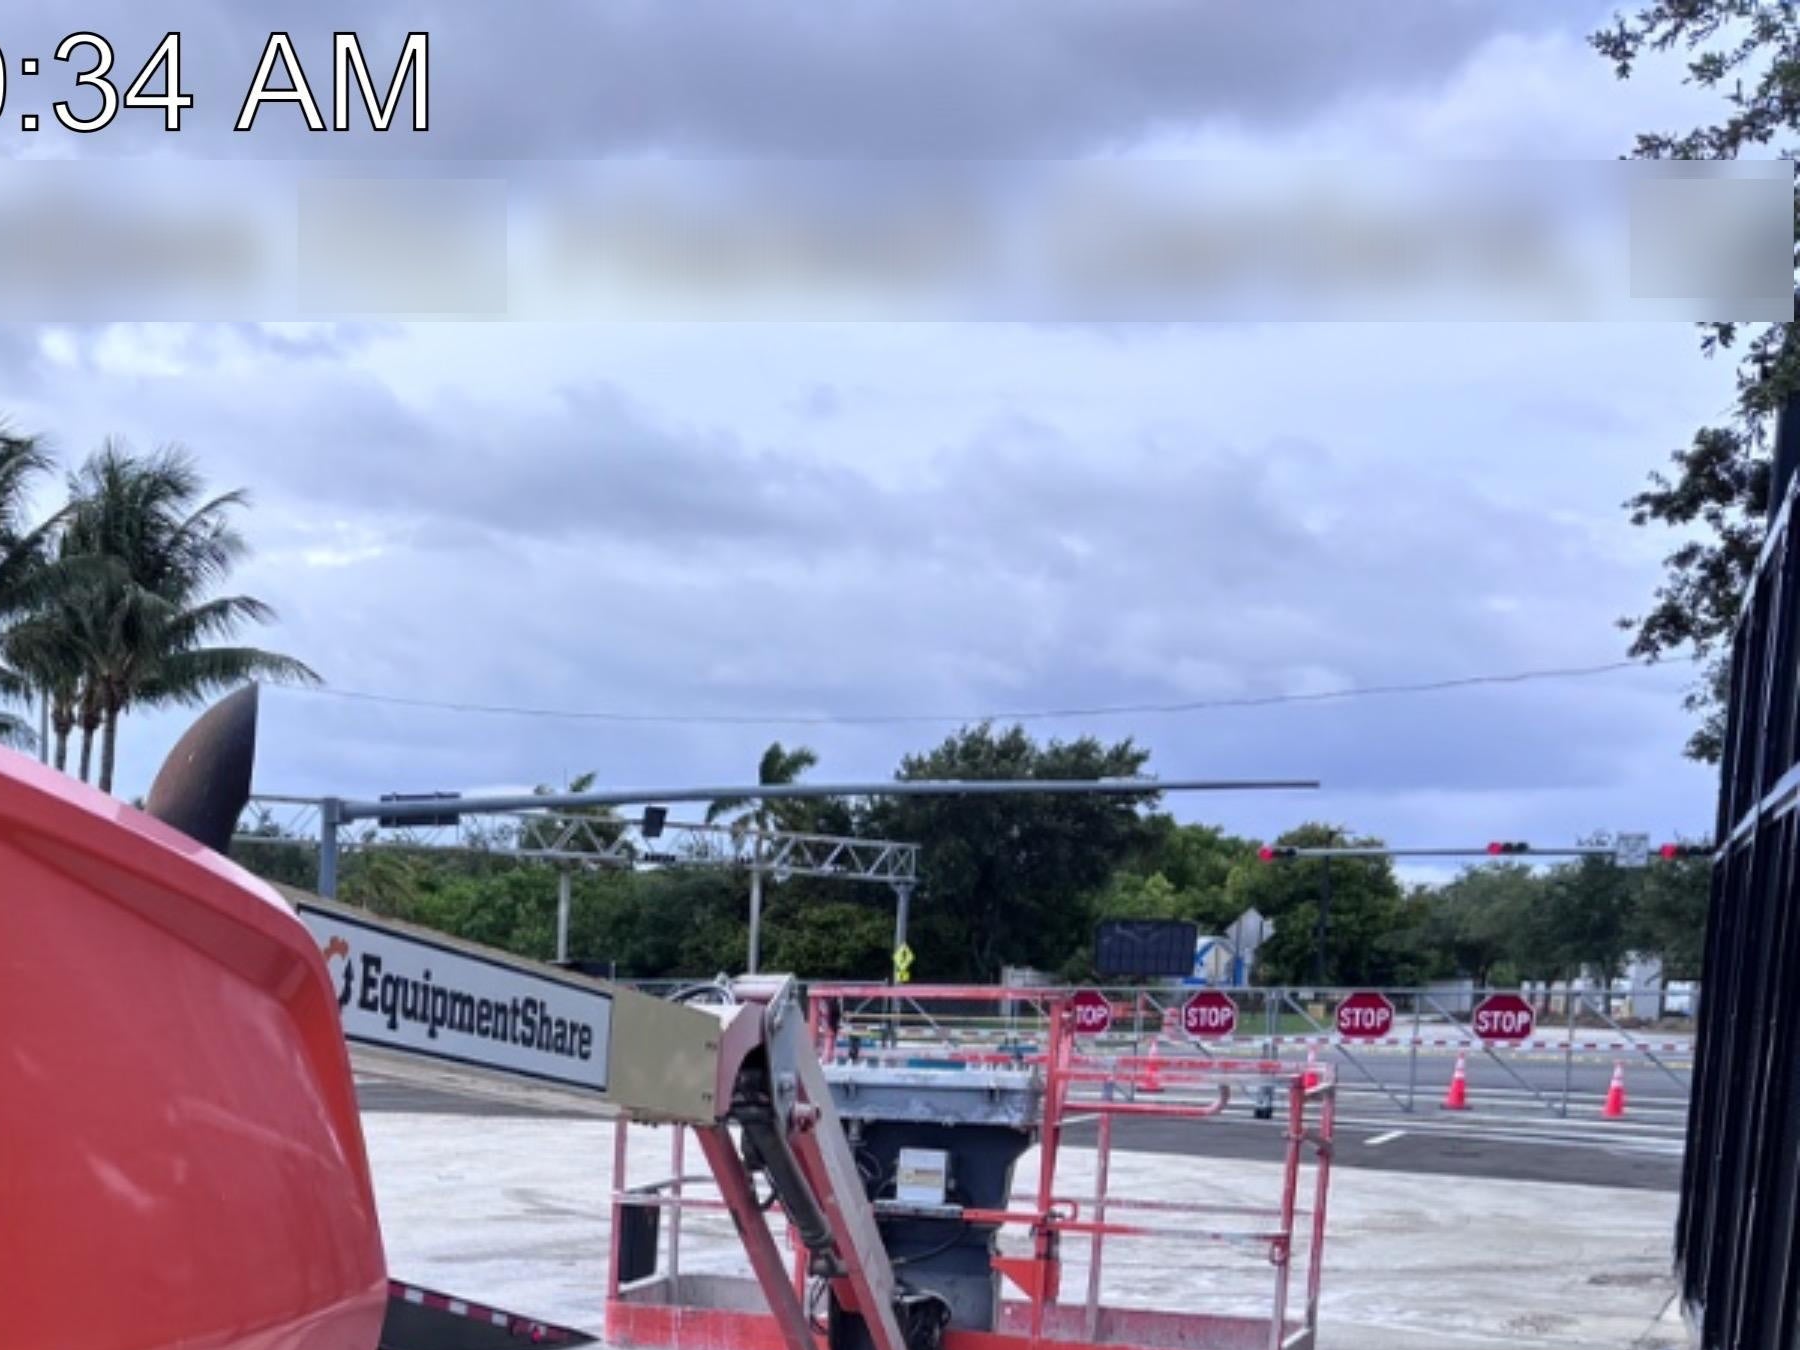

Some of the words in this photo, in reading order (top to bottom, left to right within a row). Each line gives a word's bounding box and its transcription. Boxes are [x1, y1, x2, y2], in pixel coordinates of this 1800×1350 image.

[357, 953, 592, 1060] EquipmentShare
[1074, 1005, 1108, 1025] TOP
[1187, 1007, 1233, 1027] STOP
[1340, 1007, 1390, 1029] STOP
[1478, 1010, 1530, 1032] STOP
